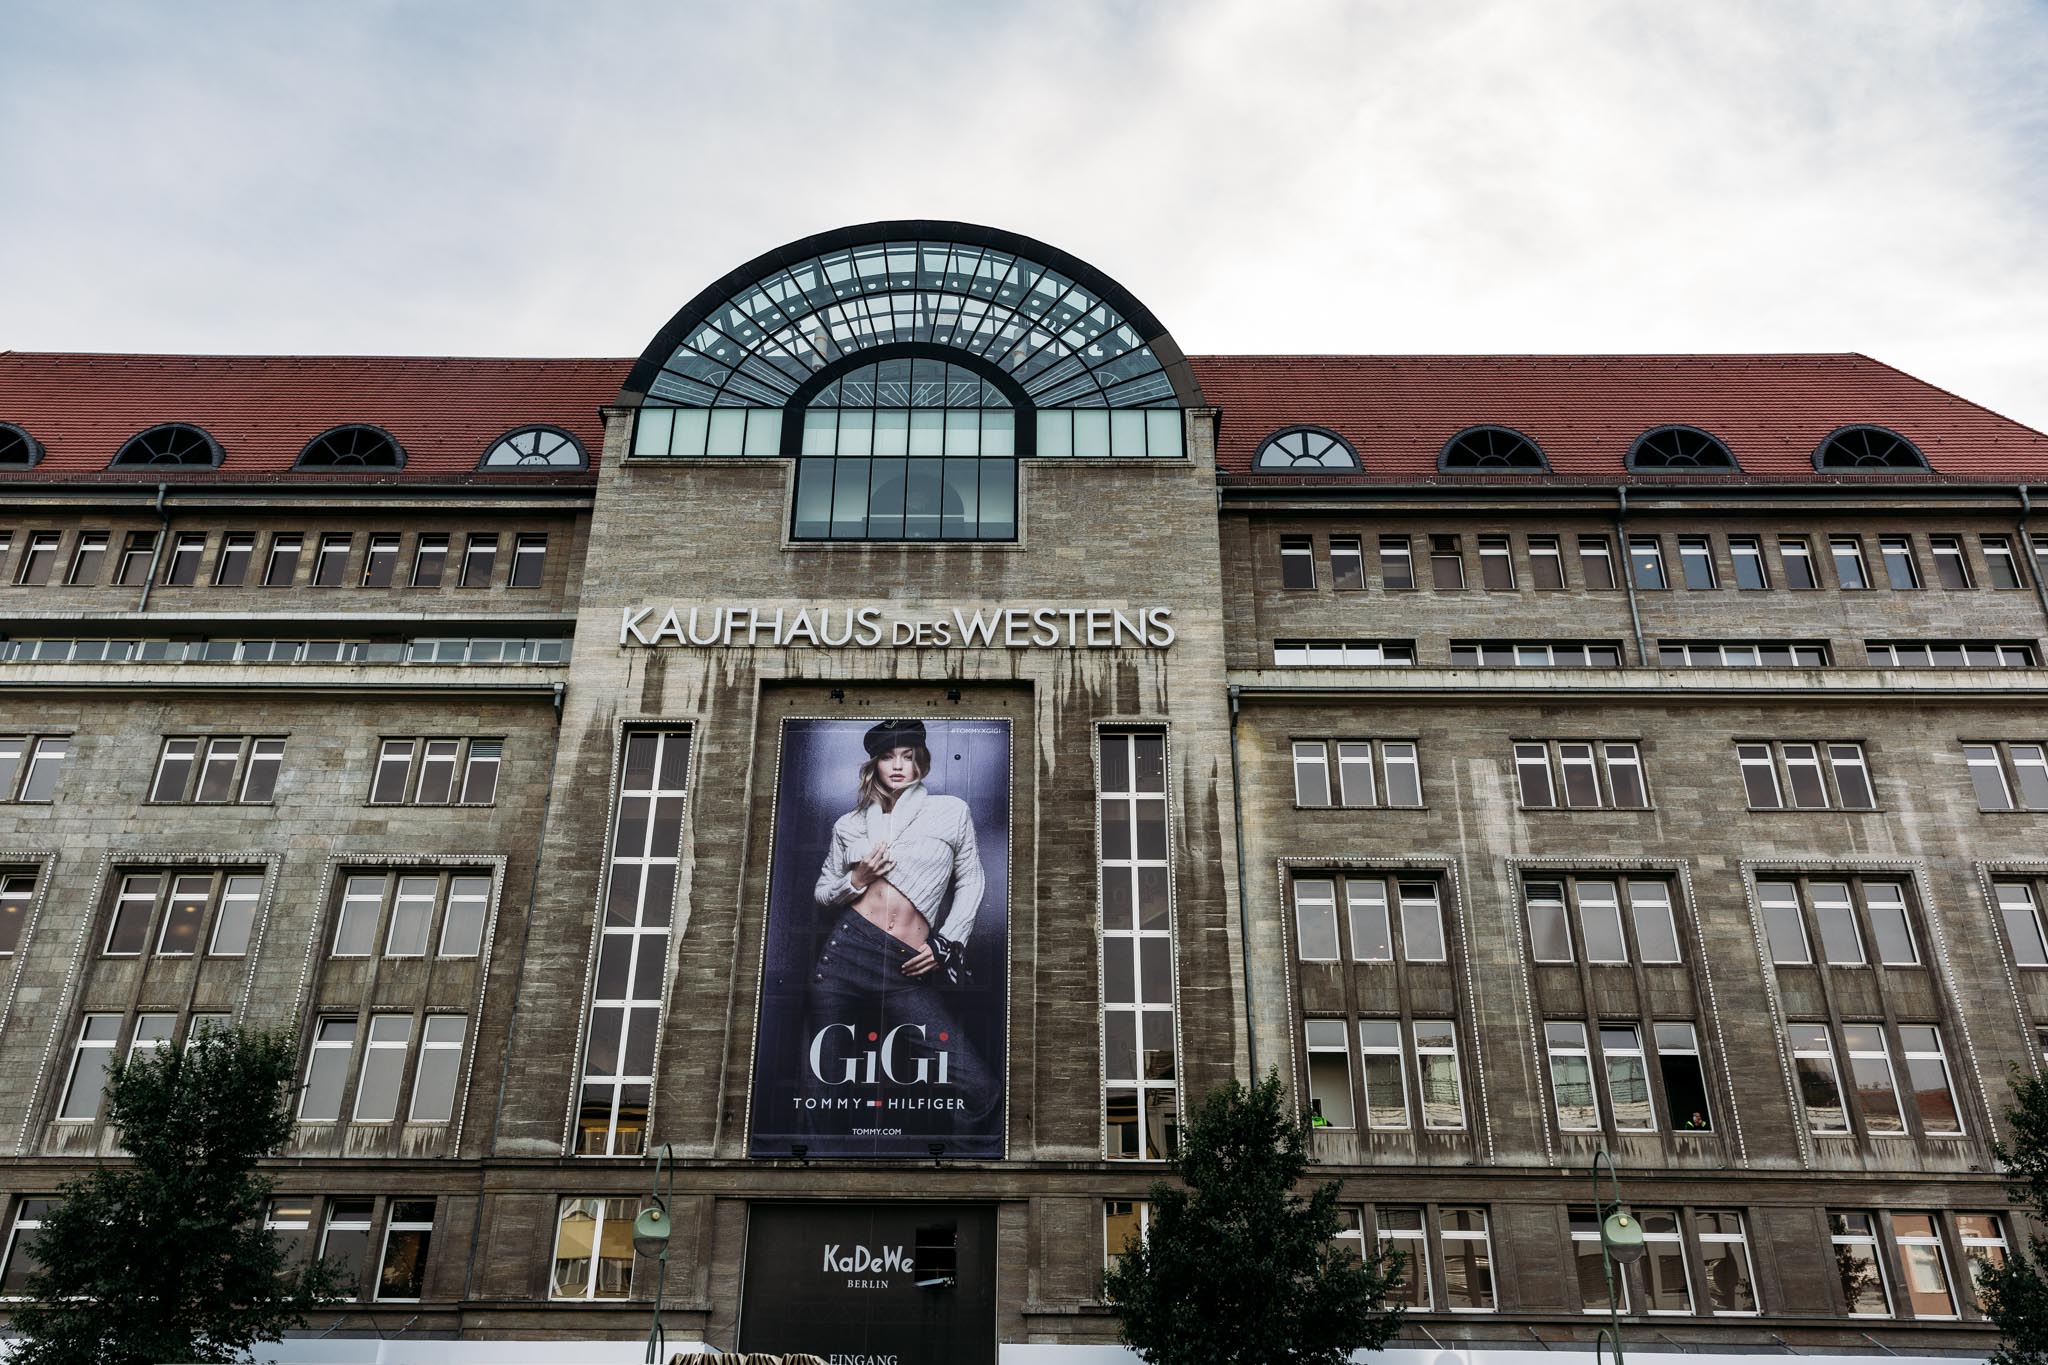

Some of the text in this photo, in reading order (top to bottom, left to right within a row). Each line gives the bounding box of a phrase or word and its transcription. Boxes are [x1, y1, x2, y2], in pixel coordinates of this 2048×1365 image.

[620, 605, 1176, 646] KAUFHAUS DES WESTENS
[809, 1023, 953, 1085] GiGi
[792, 1097, 966, 1110] TOMMY HILFIGER
[851, 1128, 902, 1136] TOMMY.COM
[823, 1244, 914, 1273] KaDeWe
[847, 1279, 889, 1289] BERLIN
[829, 1354, 898, 1365] EINGANG
